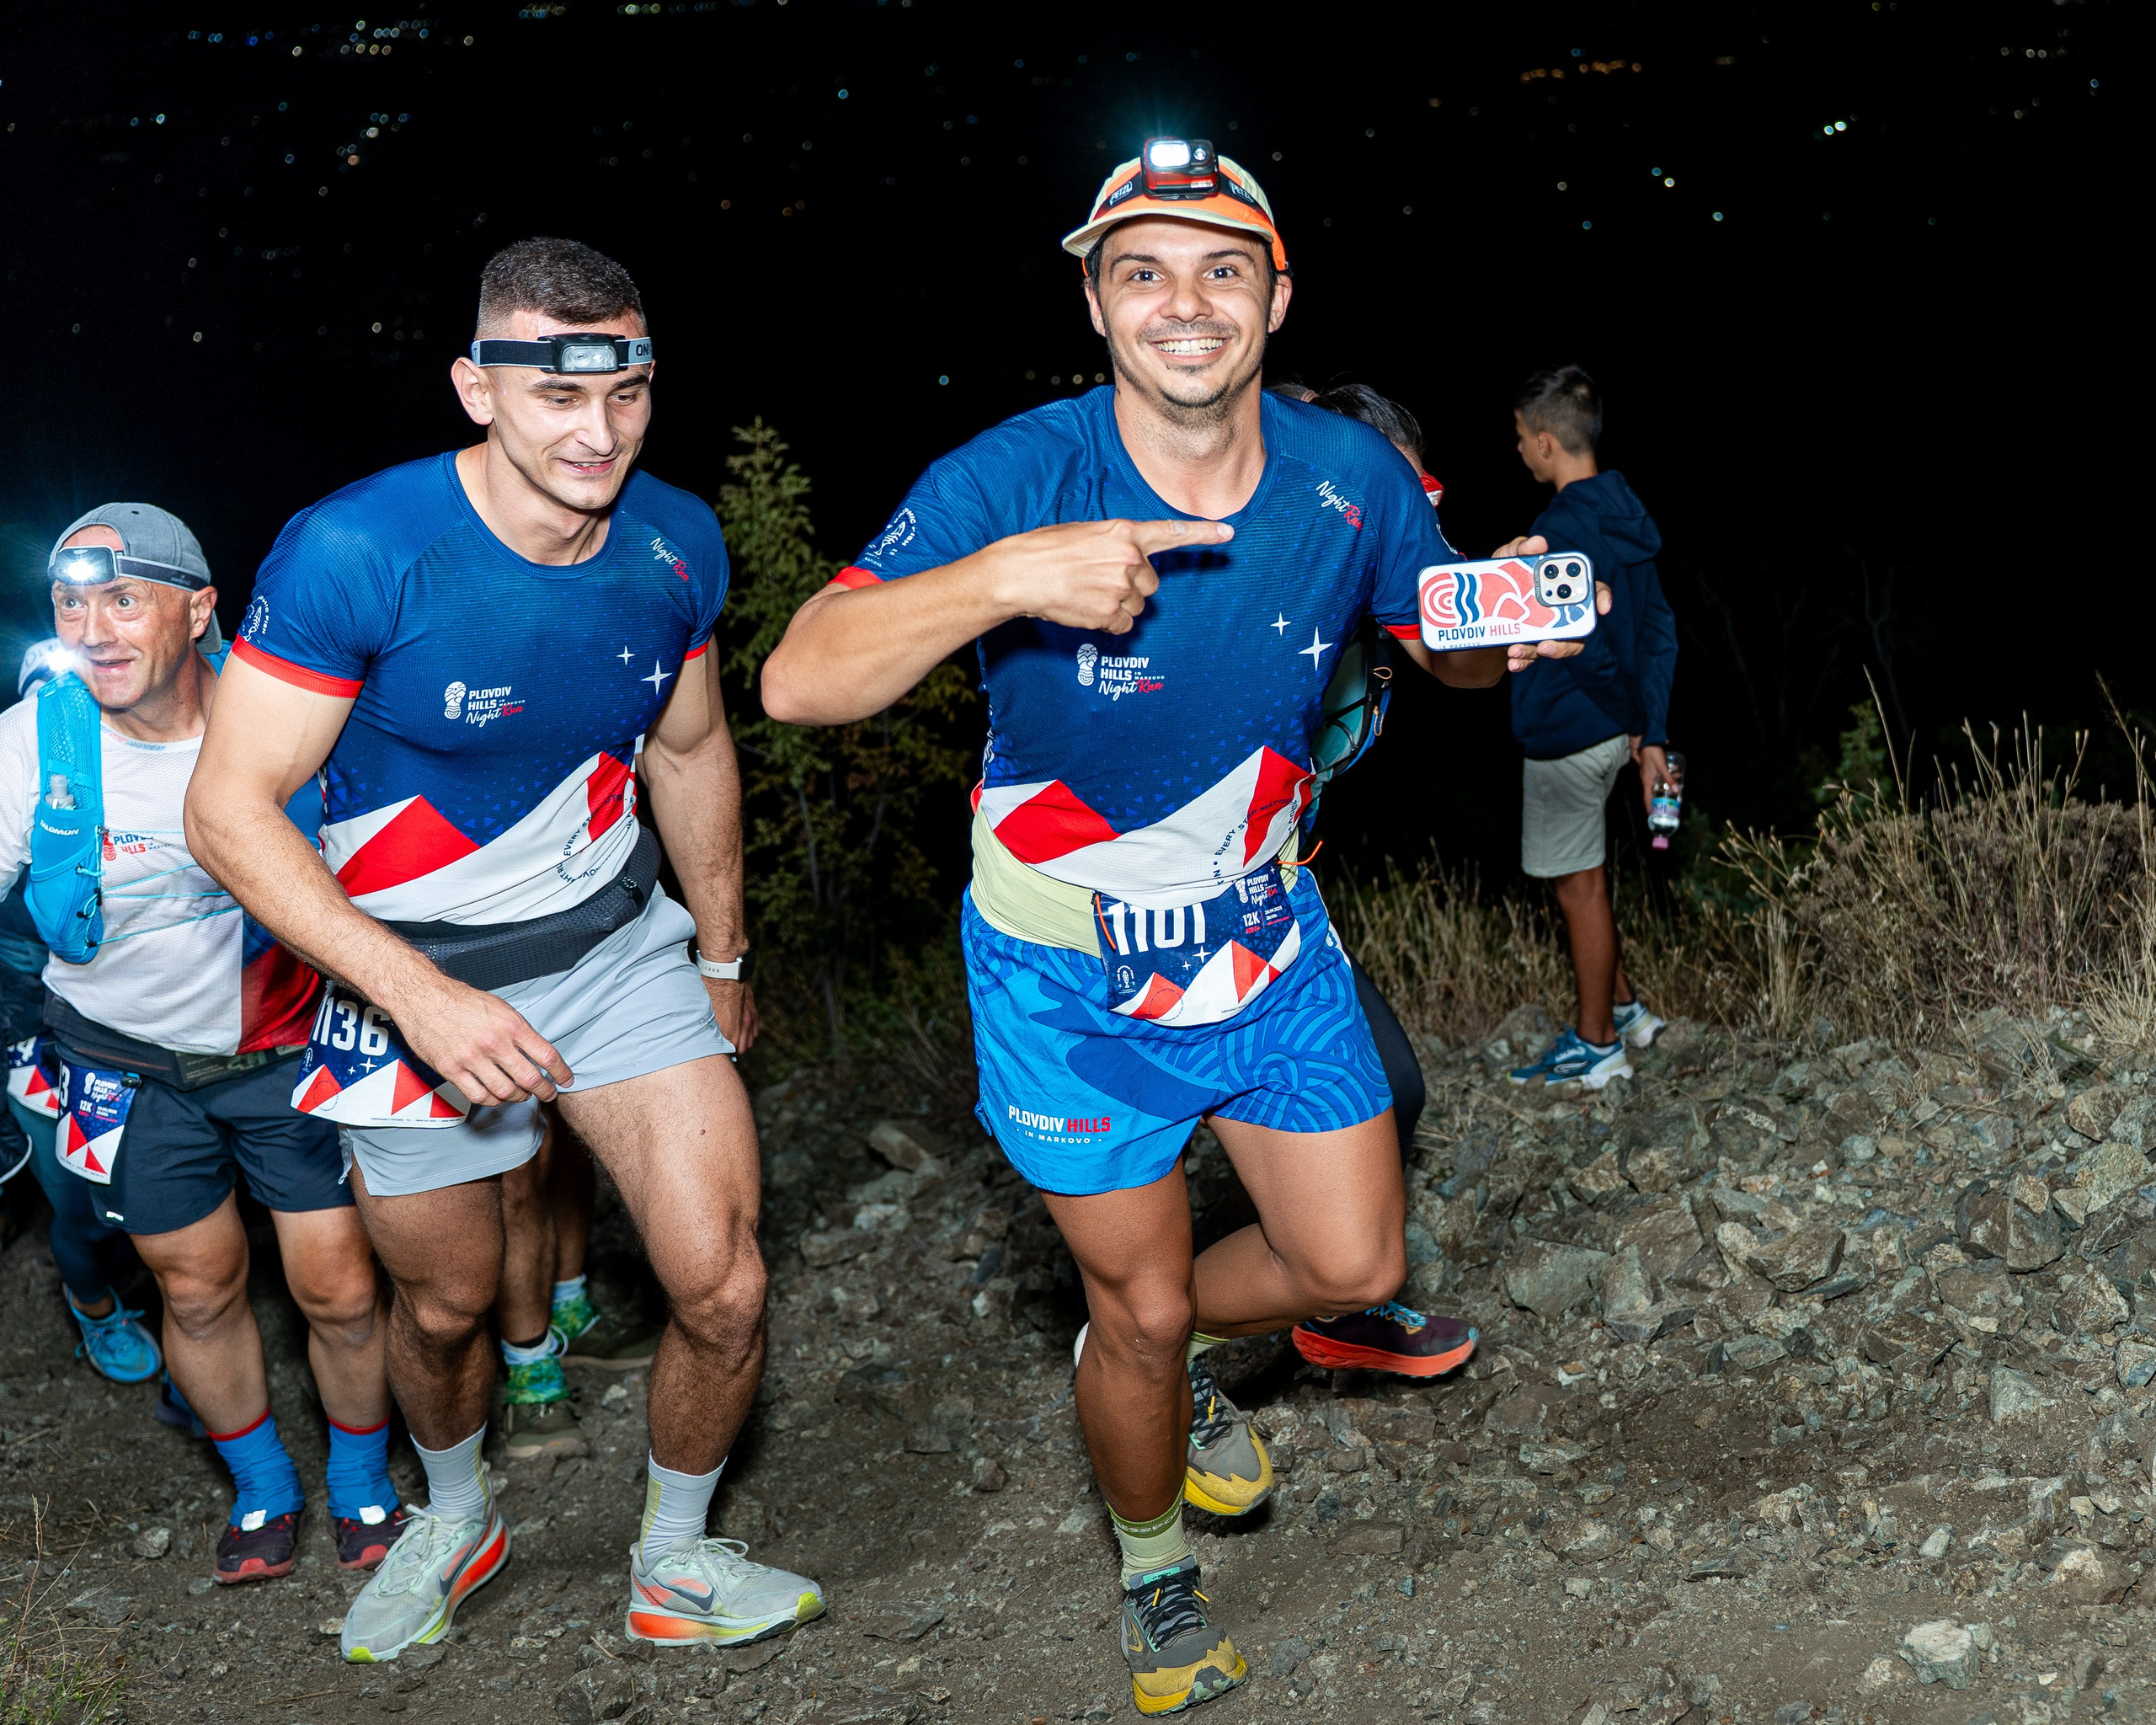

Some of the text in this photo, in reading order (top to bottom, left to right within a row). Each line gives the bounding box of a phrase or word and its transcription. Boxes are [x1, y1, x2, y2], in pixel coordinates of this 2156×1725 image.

[1109, 181, 1133, 206] PETZL
[1230, 181, 1254, 203] PETZL
[1315, 480, 1350, 512] Night
[650, 537, 689, 582] Night Run
[1438, 623, 1520, 641] PLOVDIV HILLS
[1101, 656, 1150, 669] PLOVDIV
[1100, 668, 1132, 681] HILLS
[469, 686, 511, 700] PLOVDIV
[1098, 678, 1164, 701] Night Run
[467, 699, 497, 711] HILLS
[466, 704, 523, 728] Night Run
[40, 820, 79, 836] SALOMON
[563, 829, 580, 856] EVERY
[1214, 829, 1235, 856] EVERY
[1248, 884, 1264, 895] HILLS
[1251, 890, 1268, 906] Night
[1107, 901, 1206, 956] 1101
[1242, 911, 1261, 927] 12K
[312, 994, 391, 1056] 1136
[80, 1100, 93, 1113] 12K
[1008, 1104, 1111, 1133] PLOVDIV HILLS
[1038, 1134, 1091, 1144] MARKOVO
